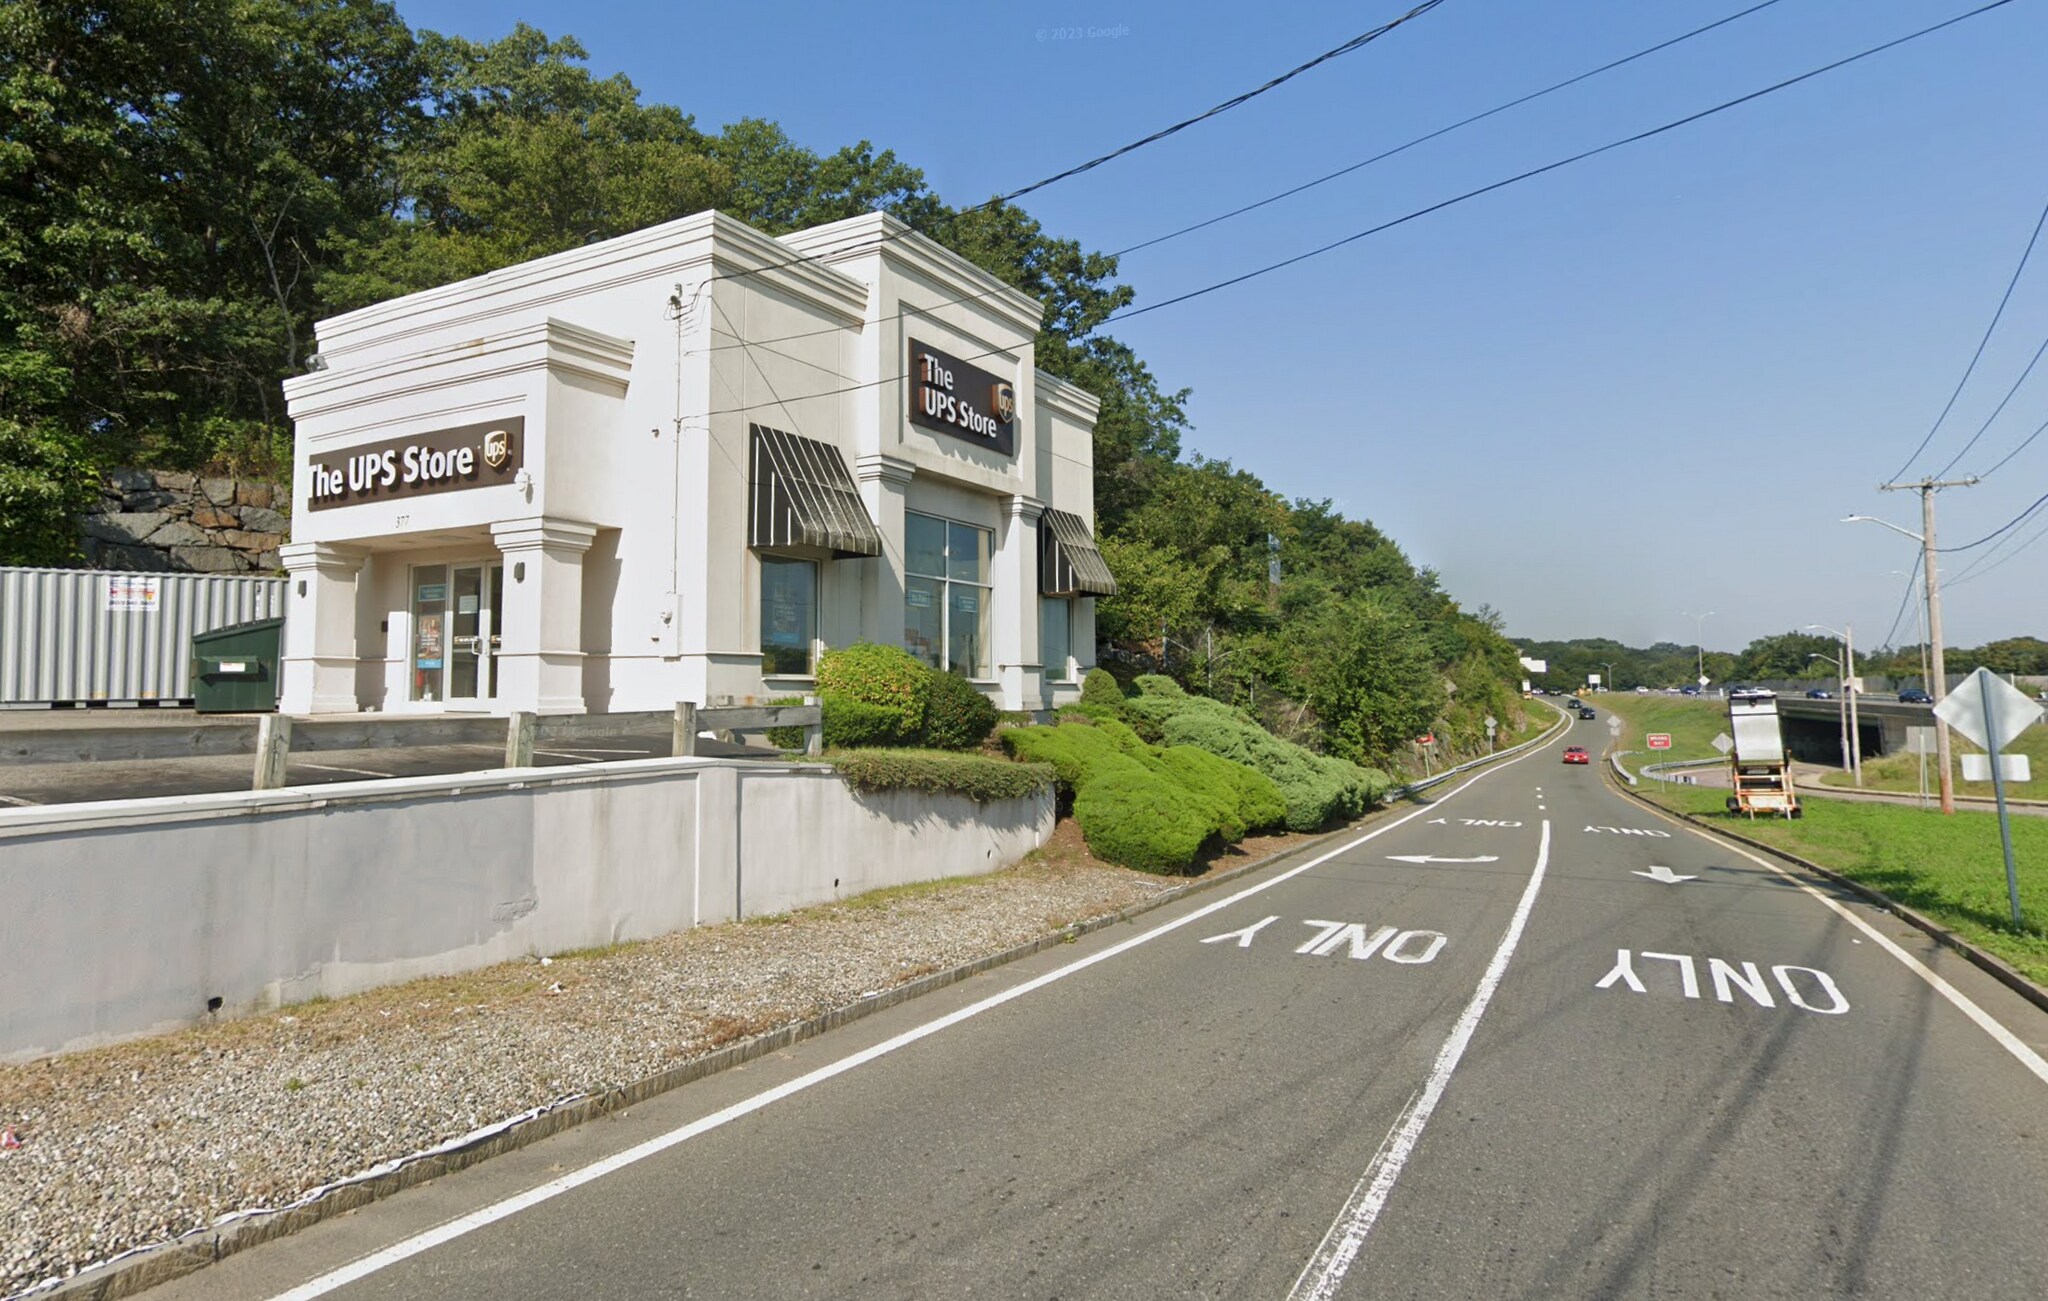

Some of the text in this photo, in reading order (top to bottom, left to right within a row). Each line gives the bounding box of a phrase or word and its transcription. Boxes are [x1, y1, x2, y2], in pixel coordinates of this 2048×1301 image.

[924, 353, 953, 390] The
[925, 388, 997, 438] UPS Store
[308, 446, 473, 498] The UPS Store
[486, 441, 505, 461] ups
[1428, 818, 1522, 829] ONLY
[1583, 826, 1672, 839] ONLY
[1199, 915, 1448, 964] ONLY
[1595, 949, 1851, 1014] ONLY
